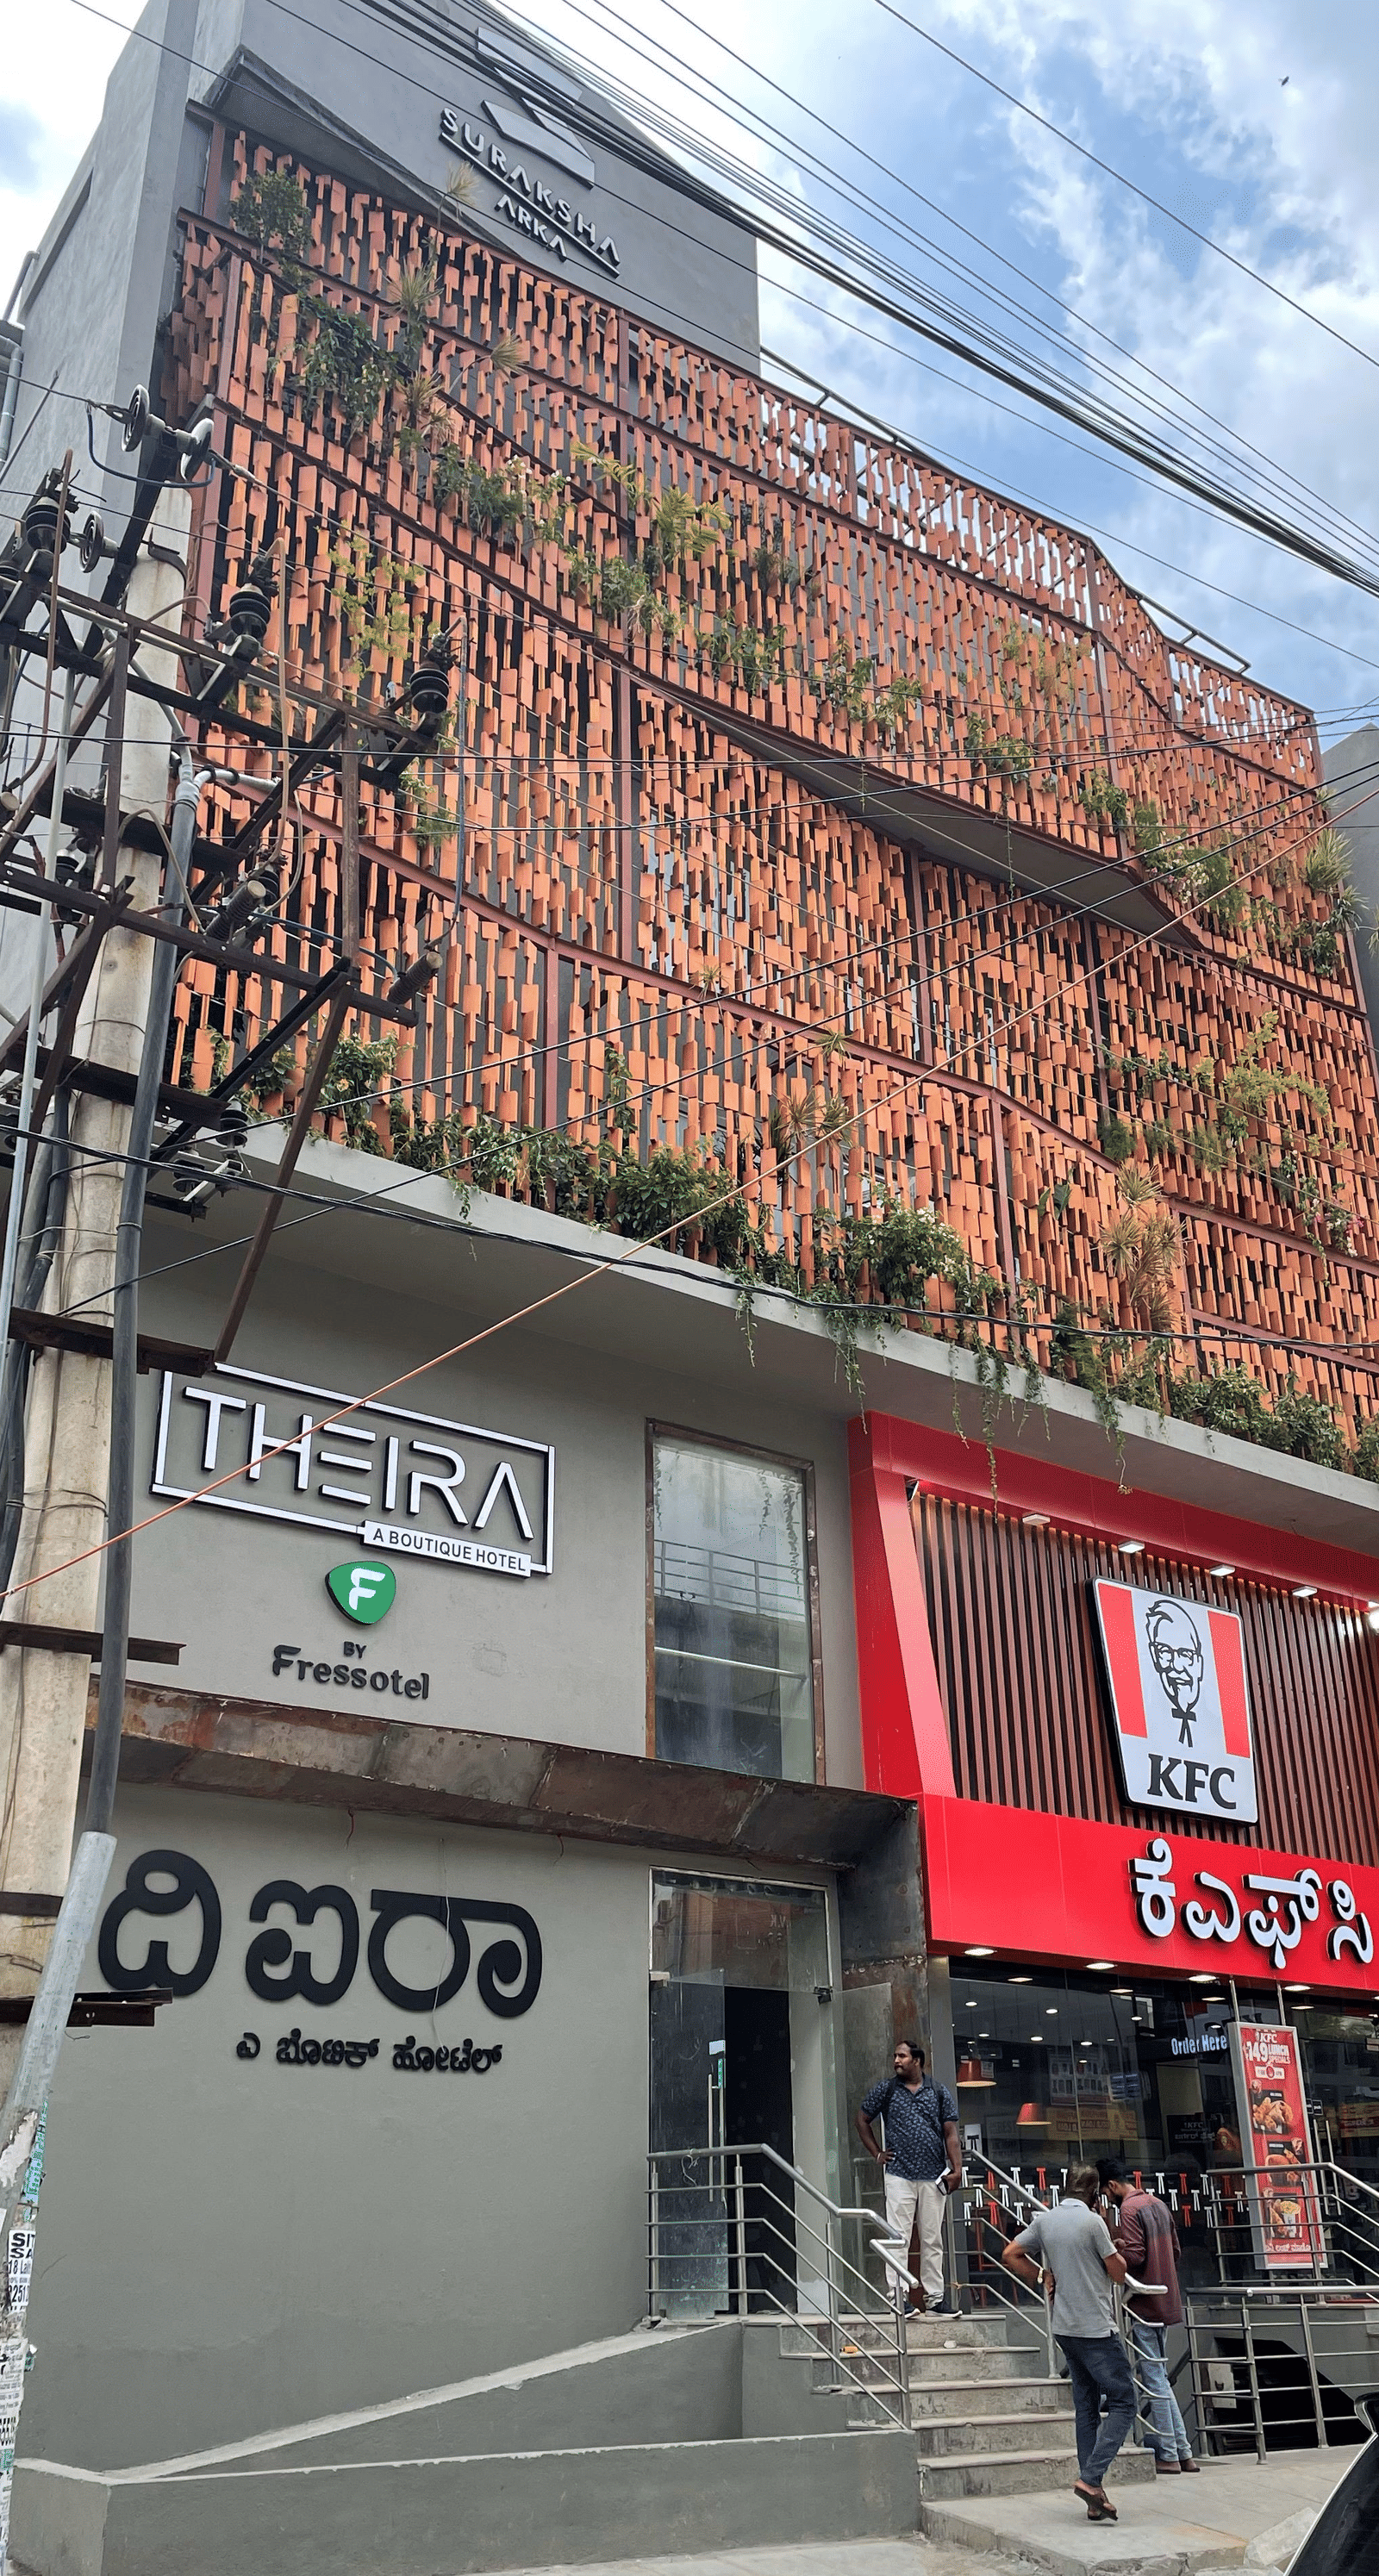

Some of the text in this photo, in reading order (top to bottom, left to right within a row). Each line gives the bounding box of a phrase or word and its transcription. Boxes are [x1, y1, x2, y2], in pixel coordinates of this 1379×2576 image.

[441, 107, 621, 265] SURAKSHA
[496, 195, 568, 262] ARKA
[183, 1386, 534, 1541] THEIRA
[372, 1527, 527, 1572] A BOUTIQUE HOTEL
[272, 1644, 429, 1700] Fressotel
[343, 1641, 366, 1658] BY
[1147, 1754, 1237, 1810] KFC
[1171, 2034, 1227, 2055] Order Here
[1259, 2032, 1278, 2043] KFC
